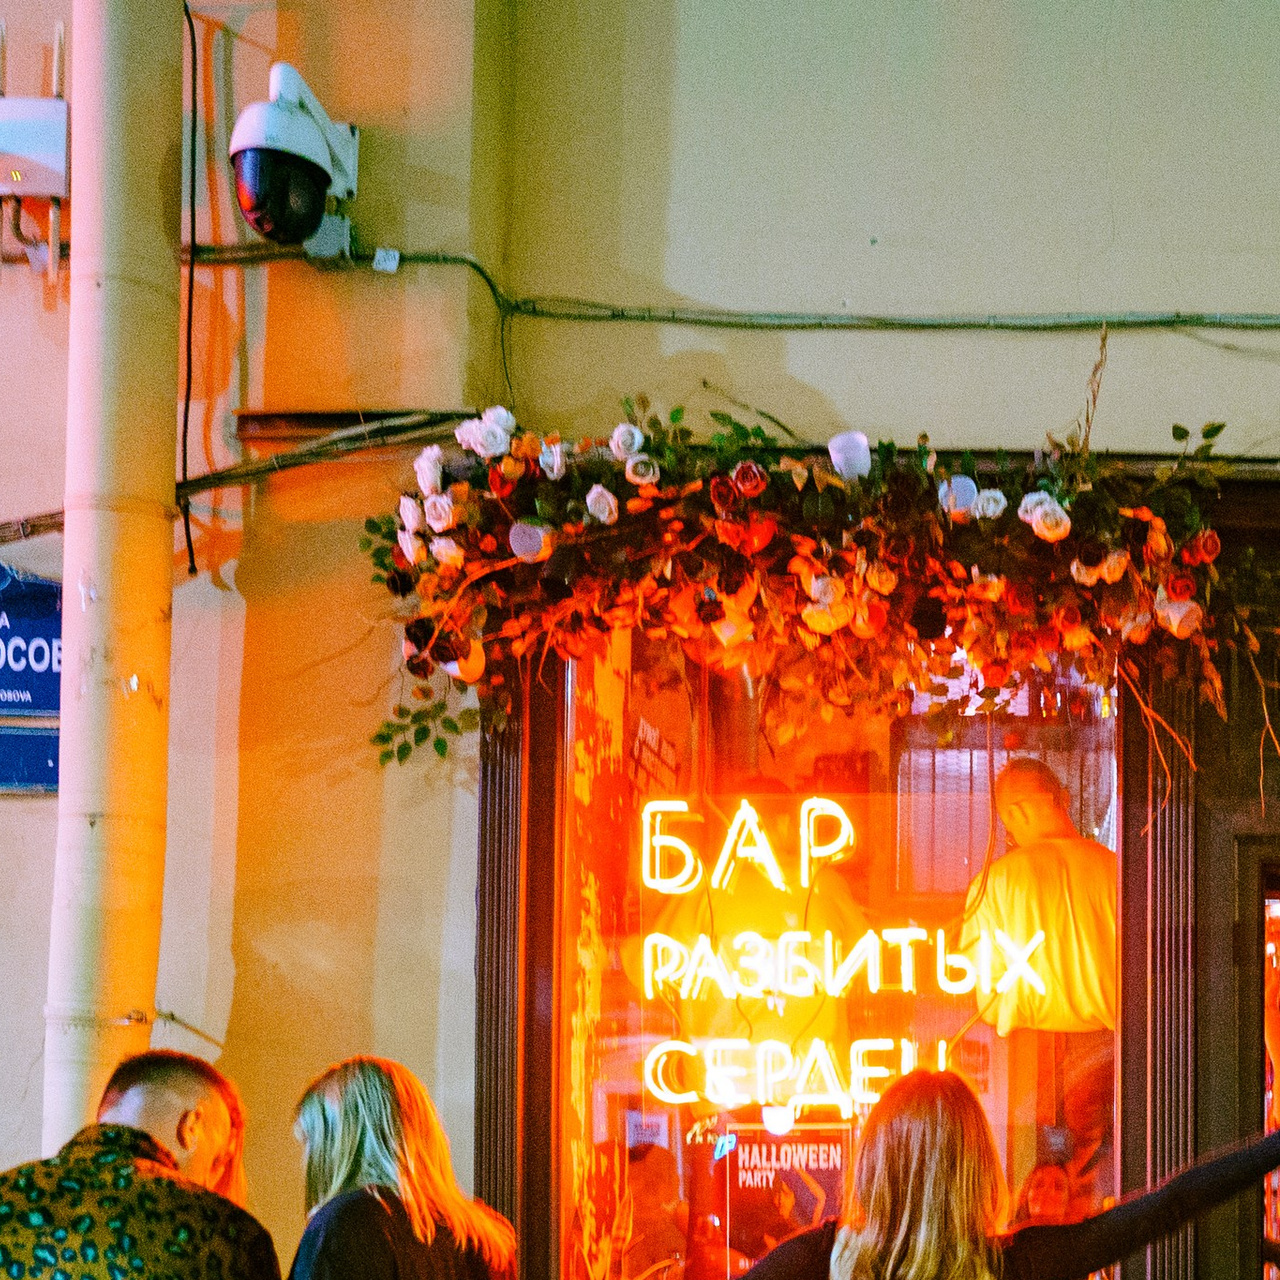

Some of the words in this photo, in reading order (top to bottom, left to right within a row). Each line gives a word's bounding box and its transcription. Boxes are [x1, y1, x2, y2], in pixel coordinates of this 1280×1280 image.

[641, 796, 856, 894] БАР
[642, 928, 1046, 999] РАЗБИТЫХ
[738, 1143, 842, 1170] HALLOWEEN
[738, 1169, 775, 1189] PARTY
